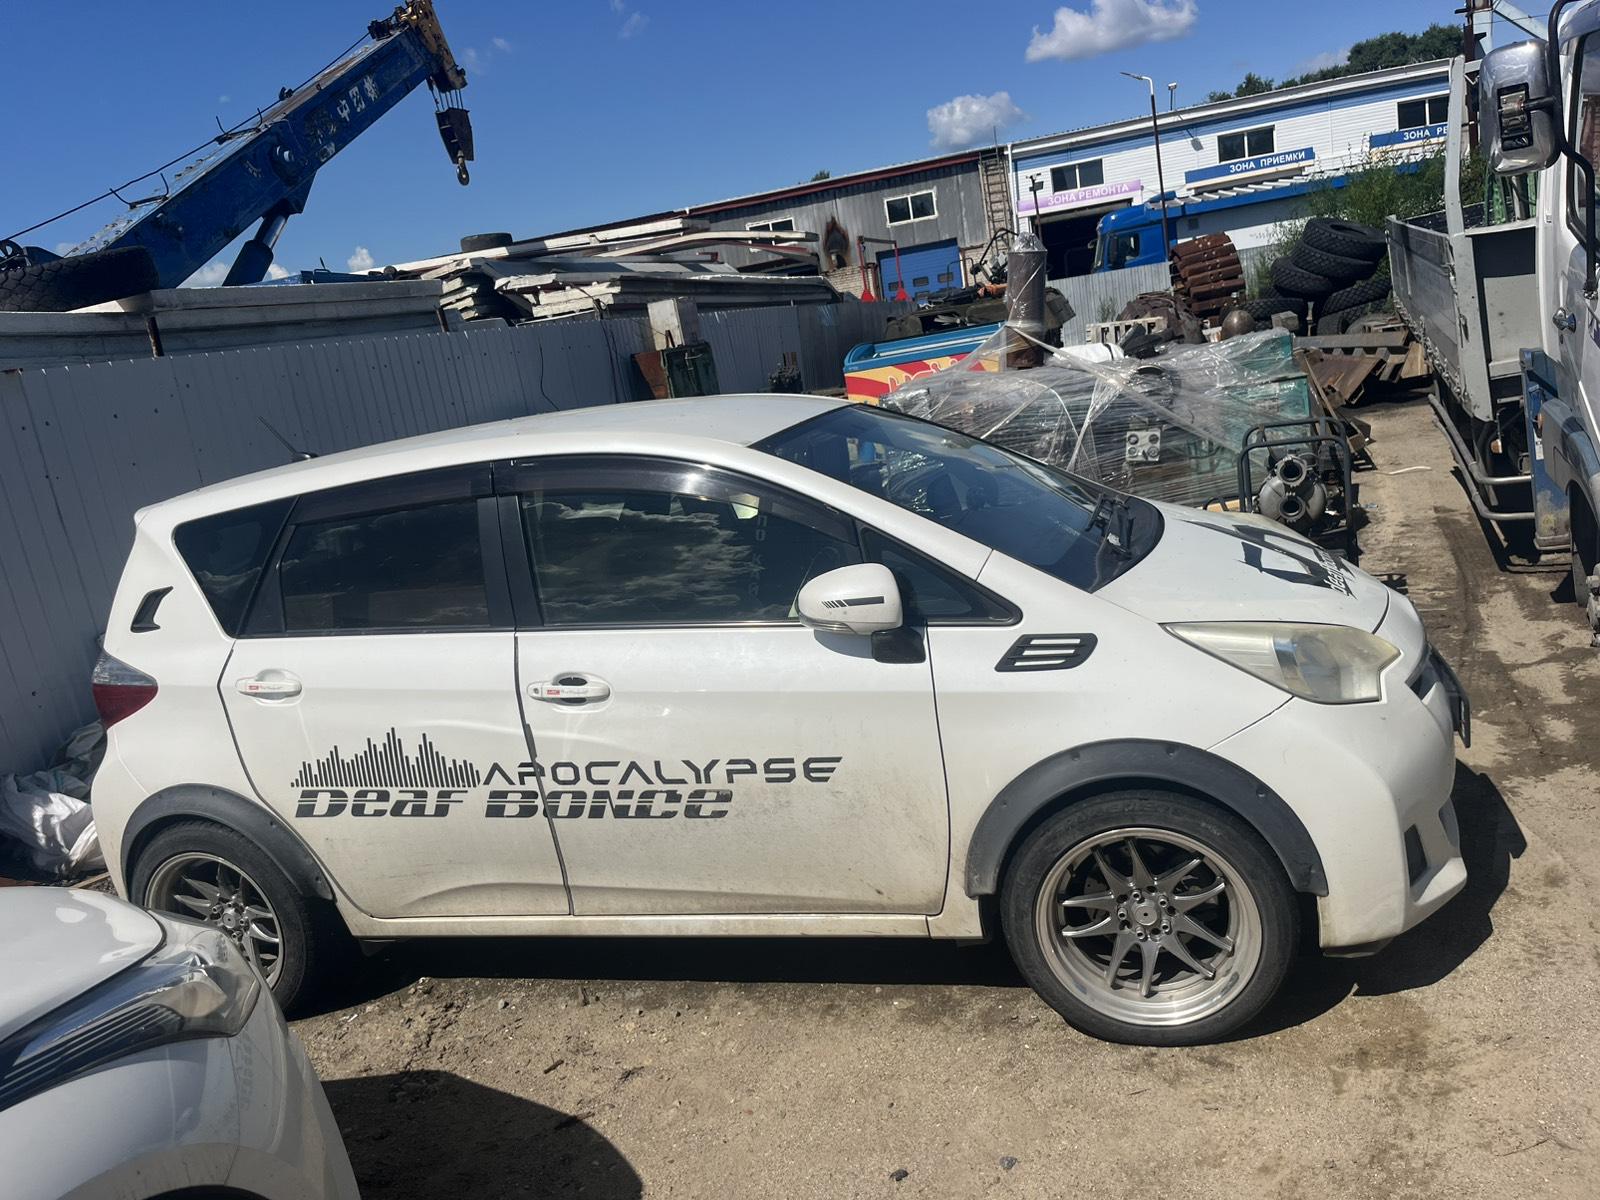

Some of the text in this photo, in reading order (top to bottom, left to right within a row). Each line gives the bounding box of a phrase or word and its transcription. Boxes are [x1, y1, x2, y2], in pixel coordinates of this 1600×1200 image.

[1403, 129, 1430, 140] ЗОНА
[1230, 151, 1305, 173] ЗОНА ПРИЕМКИ
[1048, 184, 1128, 206] ЗОНА РЕМОНТА
[483, 757, 842, 785] APOCALYPSE
